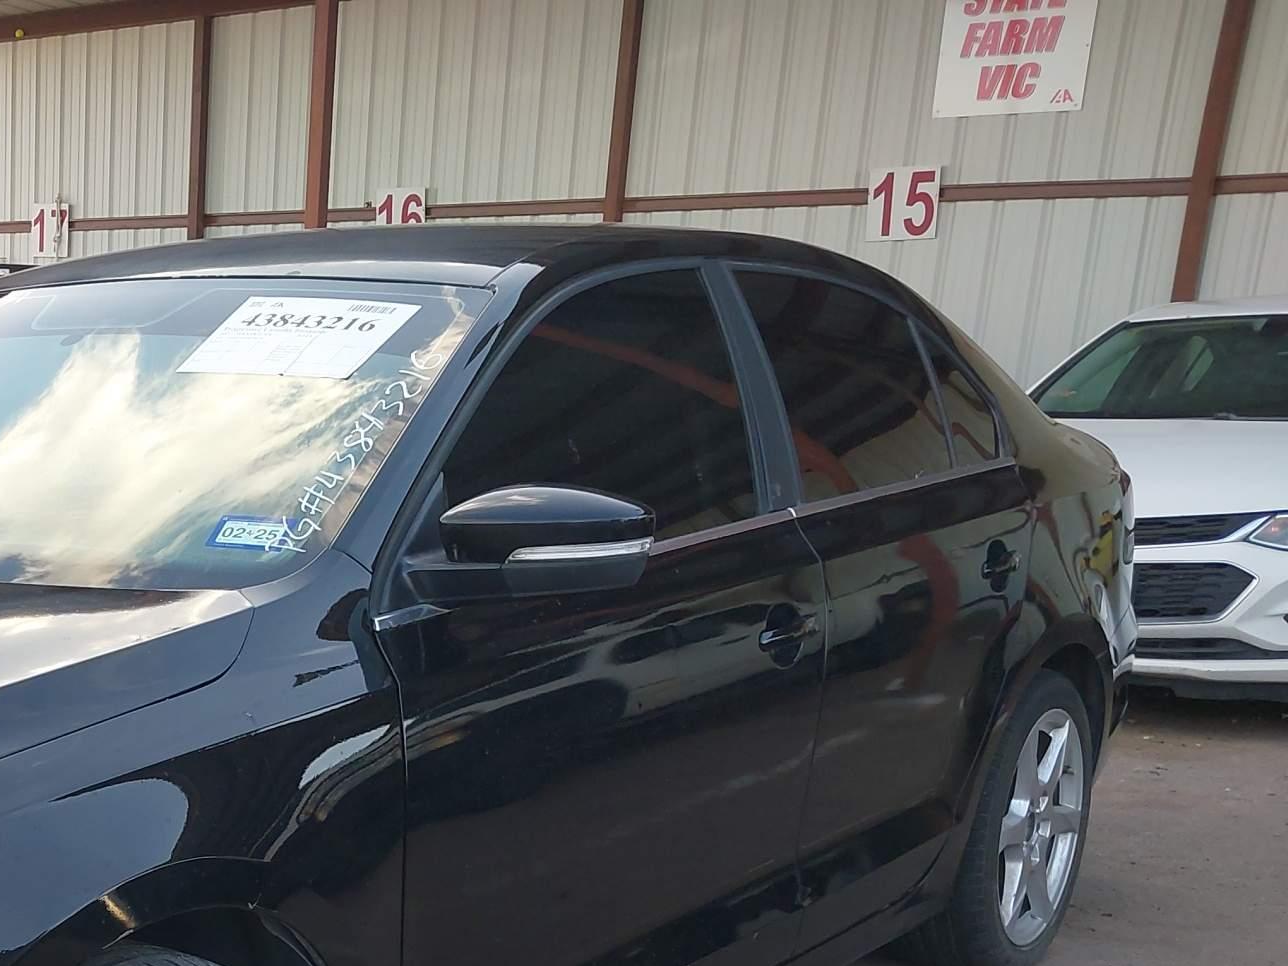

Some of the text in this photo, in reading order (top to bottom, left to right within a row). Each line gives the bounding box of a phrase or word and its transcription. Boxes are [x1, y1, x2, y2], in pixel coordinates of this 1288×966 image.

[960, 15, 1065, 58] FARM
[976, 62, 1042, 101] VIC
[378, 193, 423, 224] 16
[873, 171, 935, 236] 15
[241, 312, 384, 332] 43843216
[221, 526, 281, 541] 02 25
